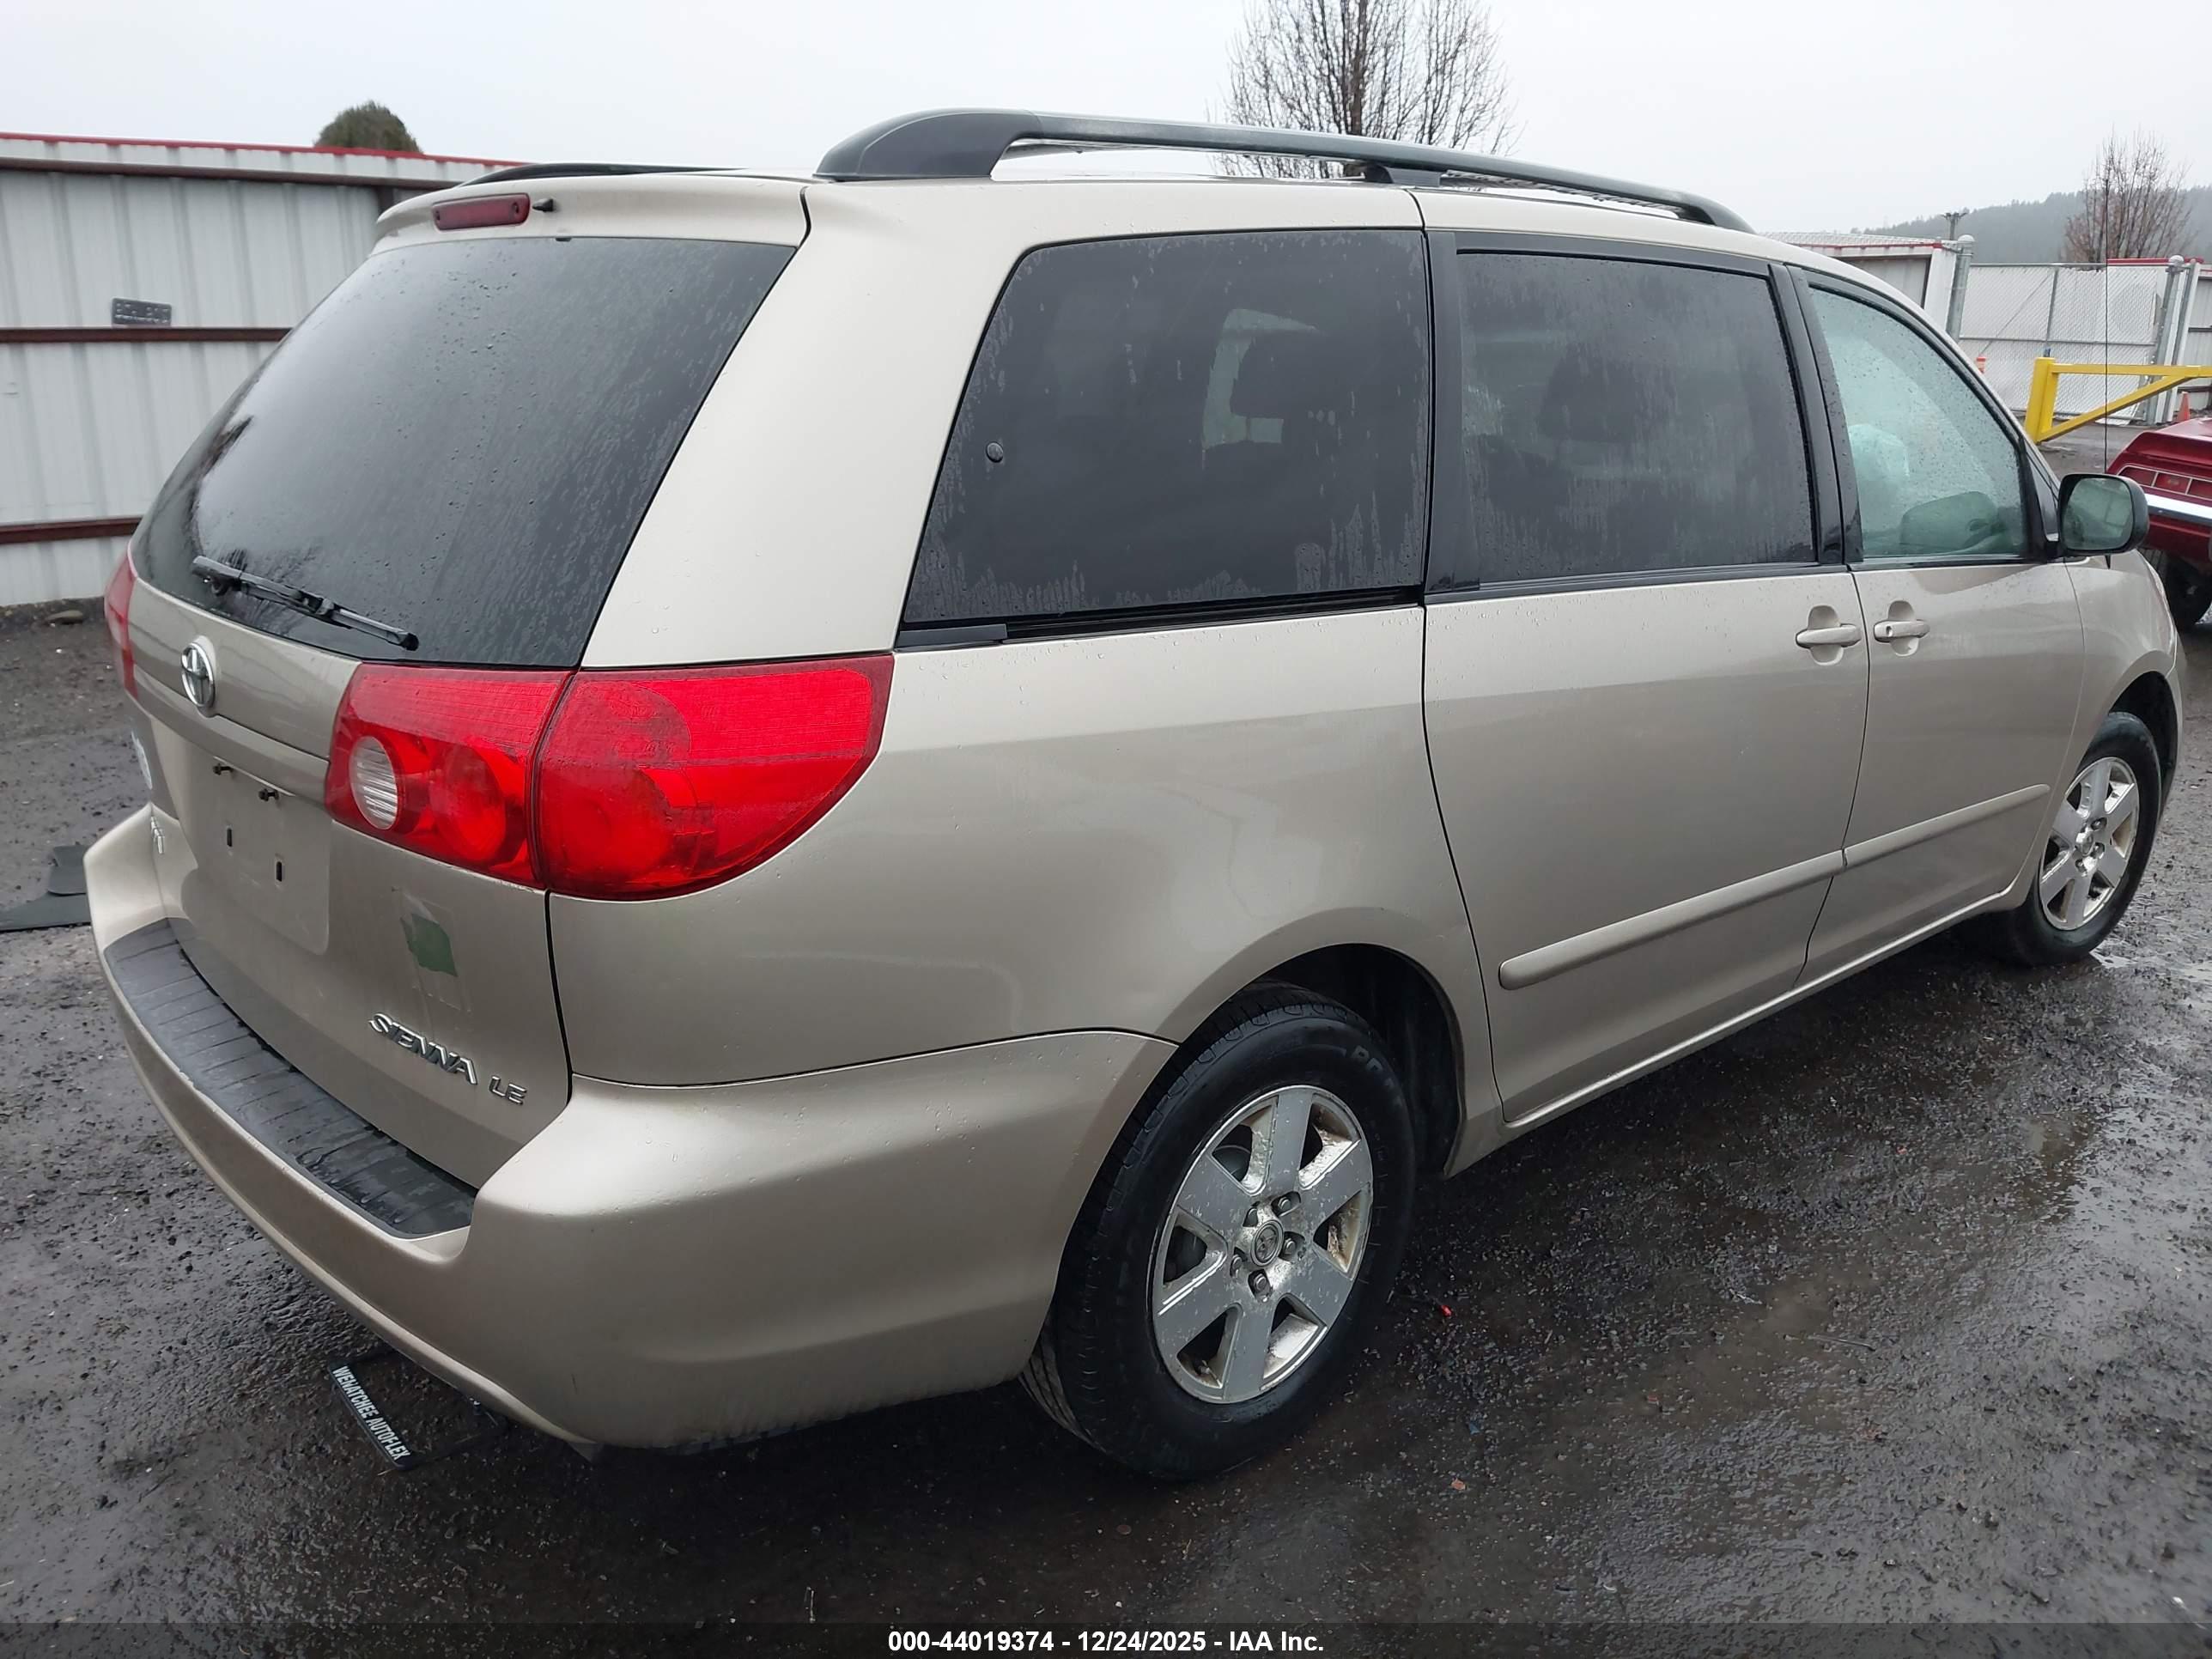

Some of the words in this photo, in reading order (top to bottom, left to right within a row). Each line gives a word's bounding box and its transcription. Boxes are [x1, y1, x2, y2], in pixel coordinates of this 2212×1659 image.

[368, 1012, 478, 1085] SIENNA
[489, 1075, 527, 1105] LE
[332, 1365, 380, 1419] WENATCHEE
[366, 1417, 410, 1461] AUTOFLEX
